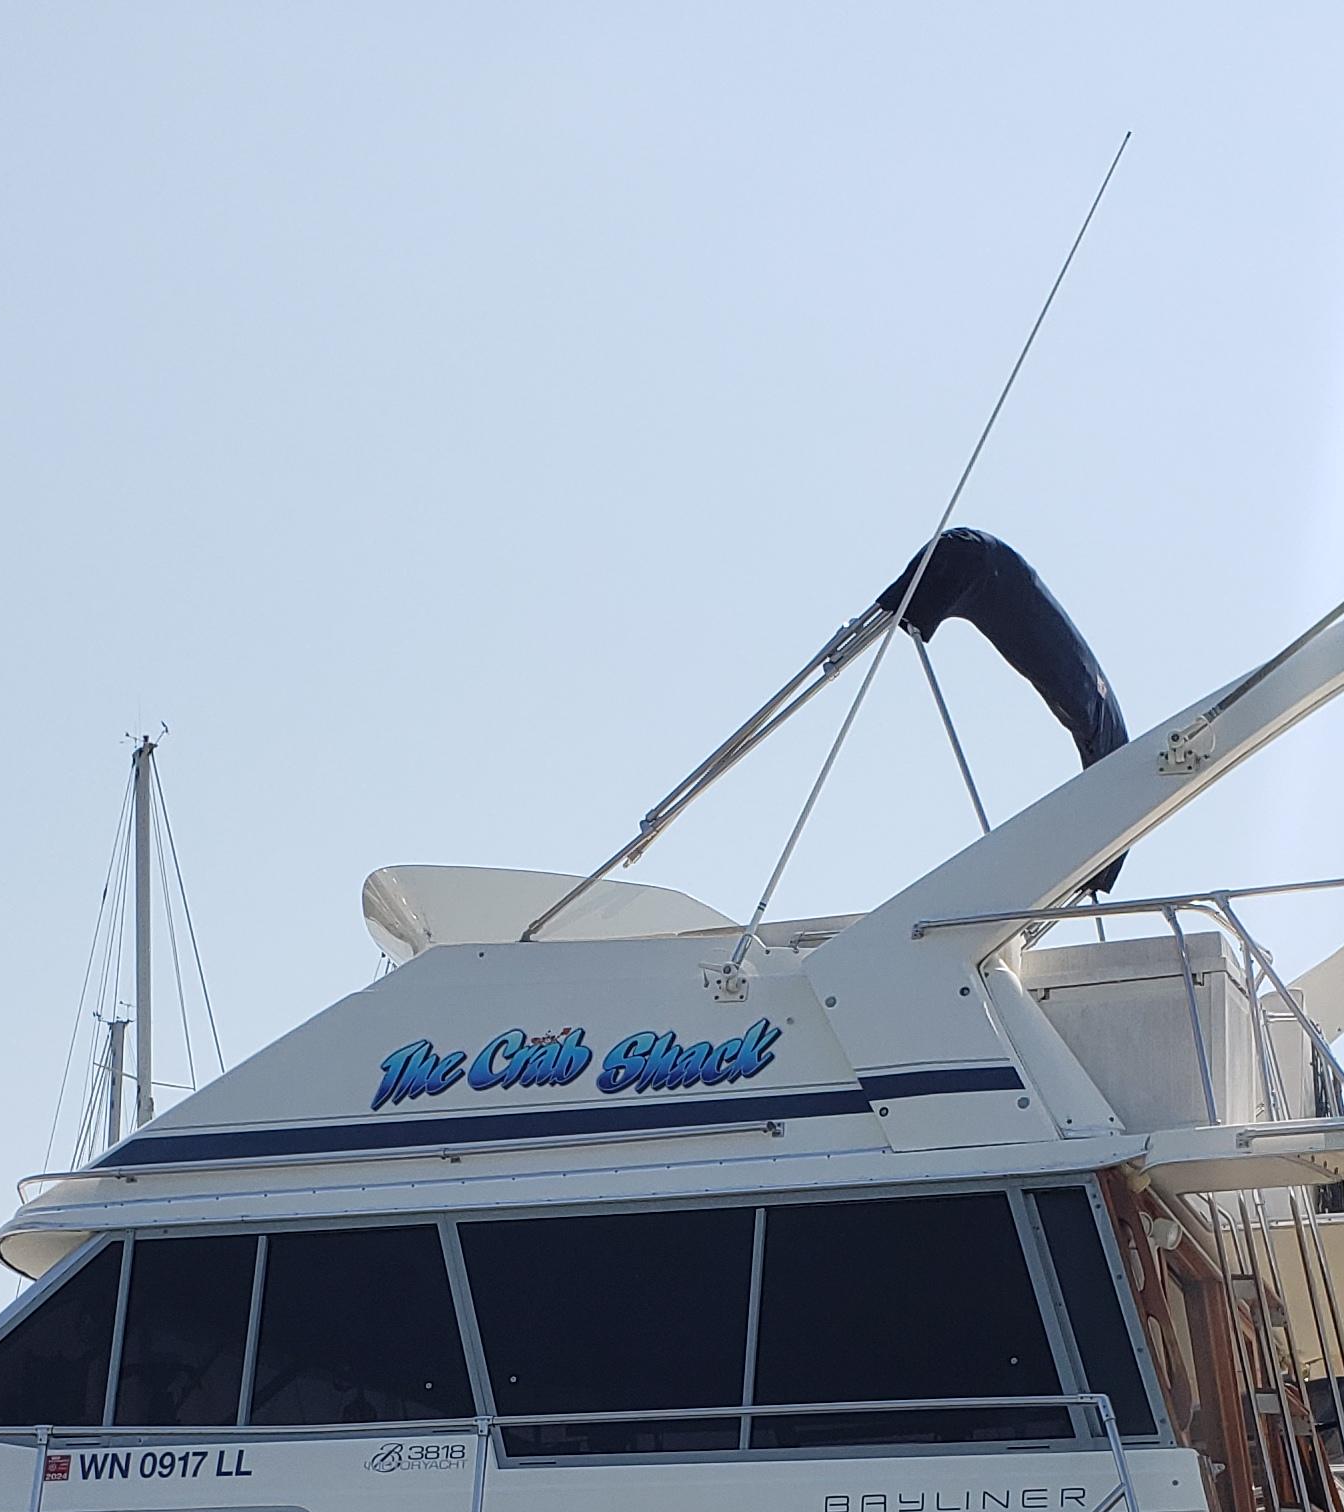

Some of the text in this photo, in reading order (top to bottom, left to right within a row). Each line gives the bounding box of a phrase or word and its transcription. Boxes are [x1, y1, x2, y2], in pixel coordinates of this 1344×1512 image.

[370, 1017, 782, 1112] The Crab Shack
[408, 1445, 466, 1460] 3818
[79, 1452, 131, 1480] WN
[139, 1451, 208, 1479] 0917
[215, 1449, 253, 1477] LL
[364, 1460, 466, 1471] MORYACHT
[46, 1472, 67, 1481] 2024
